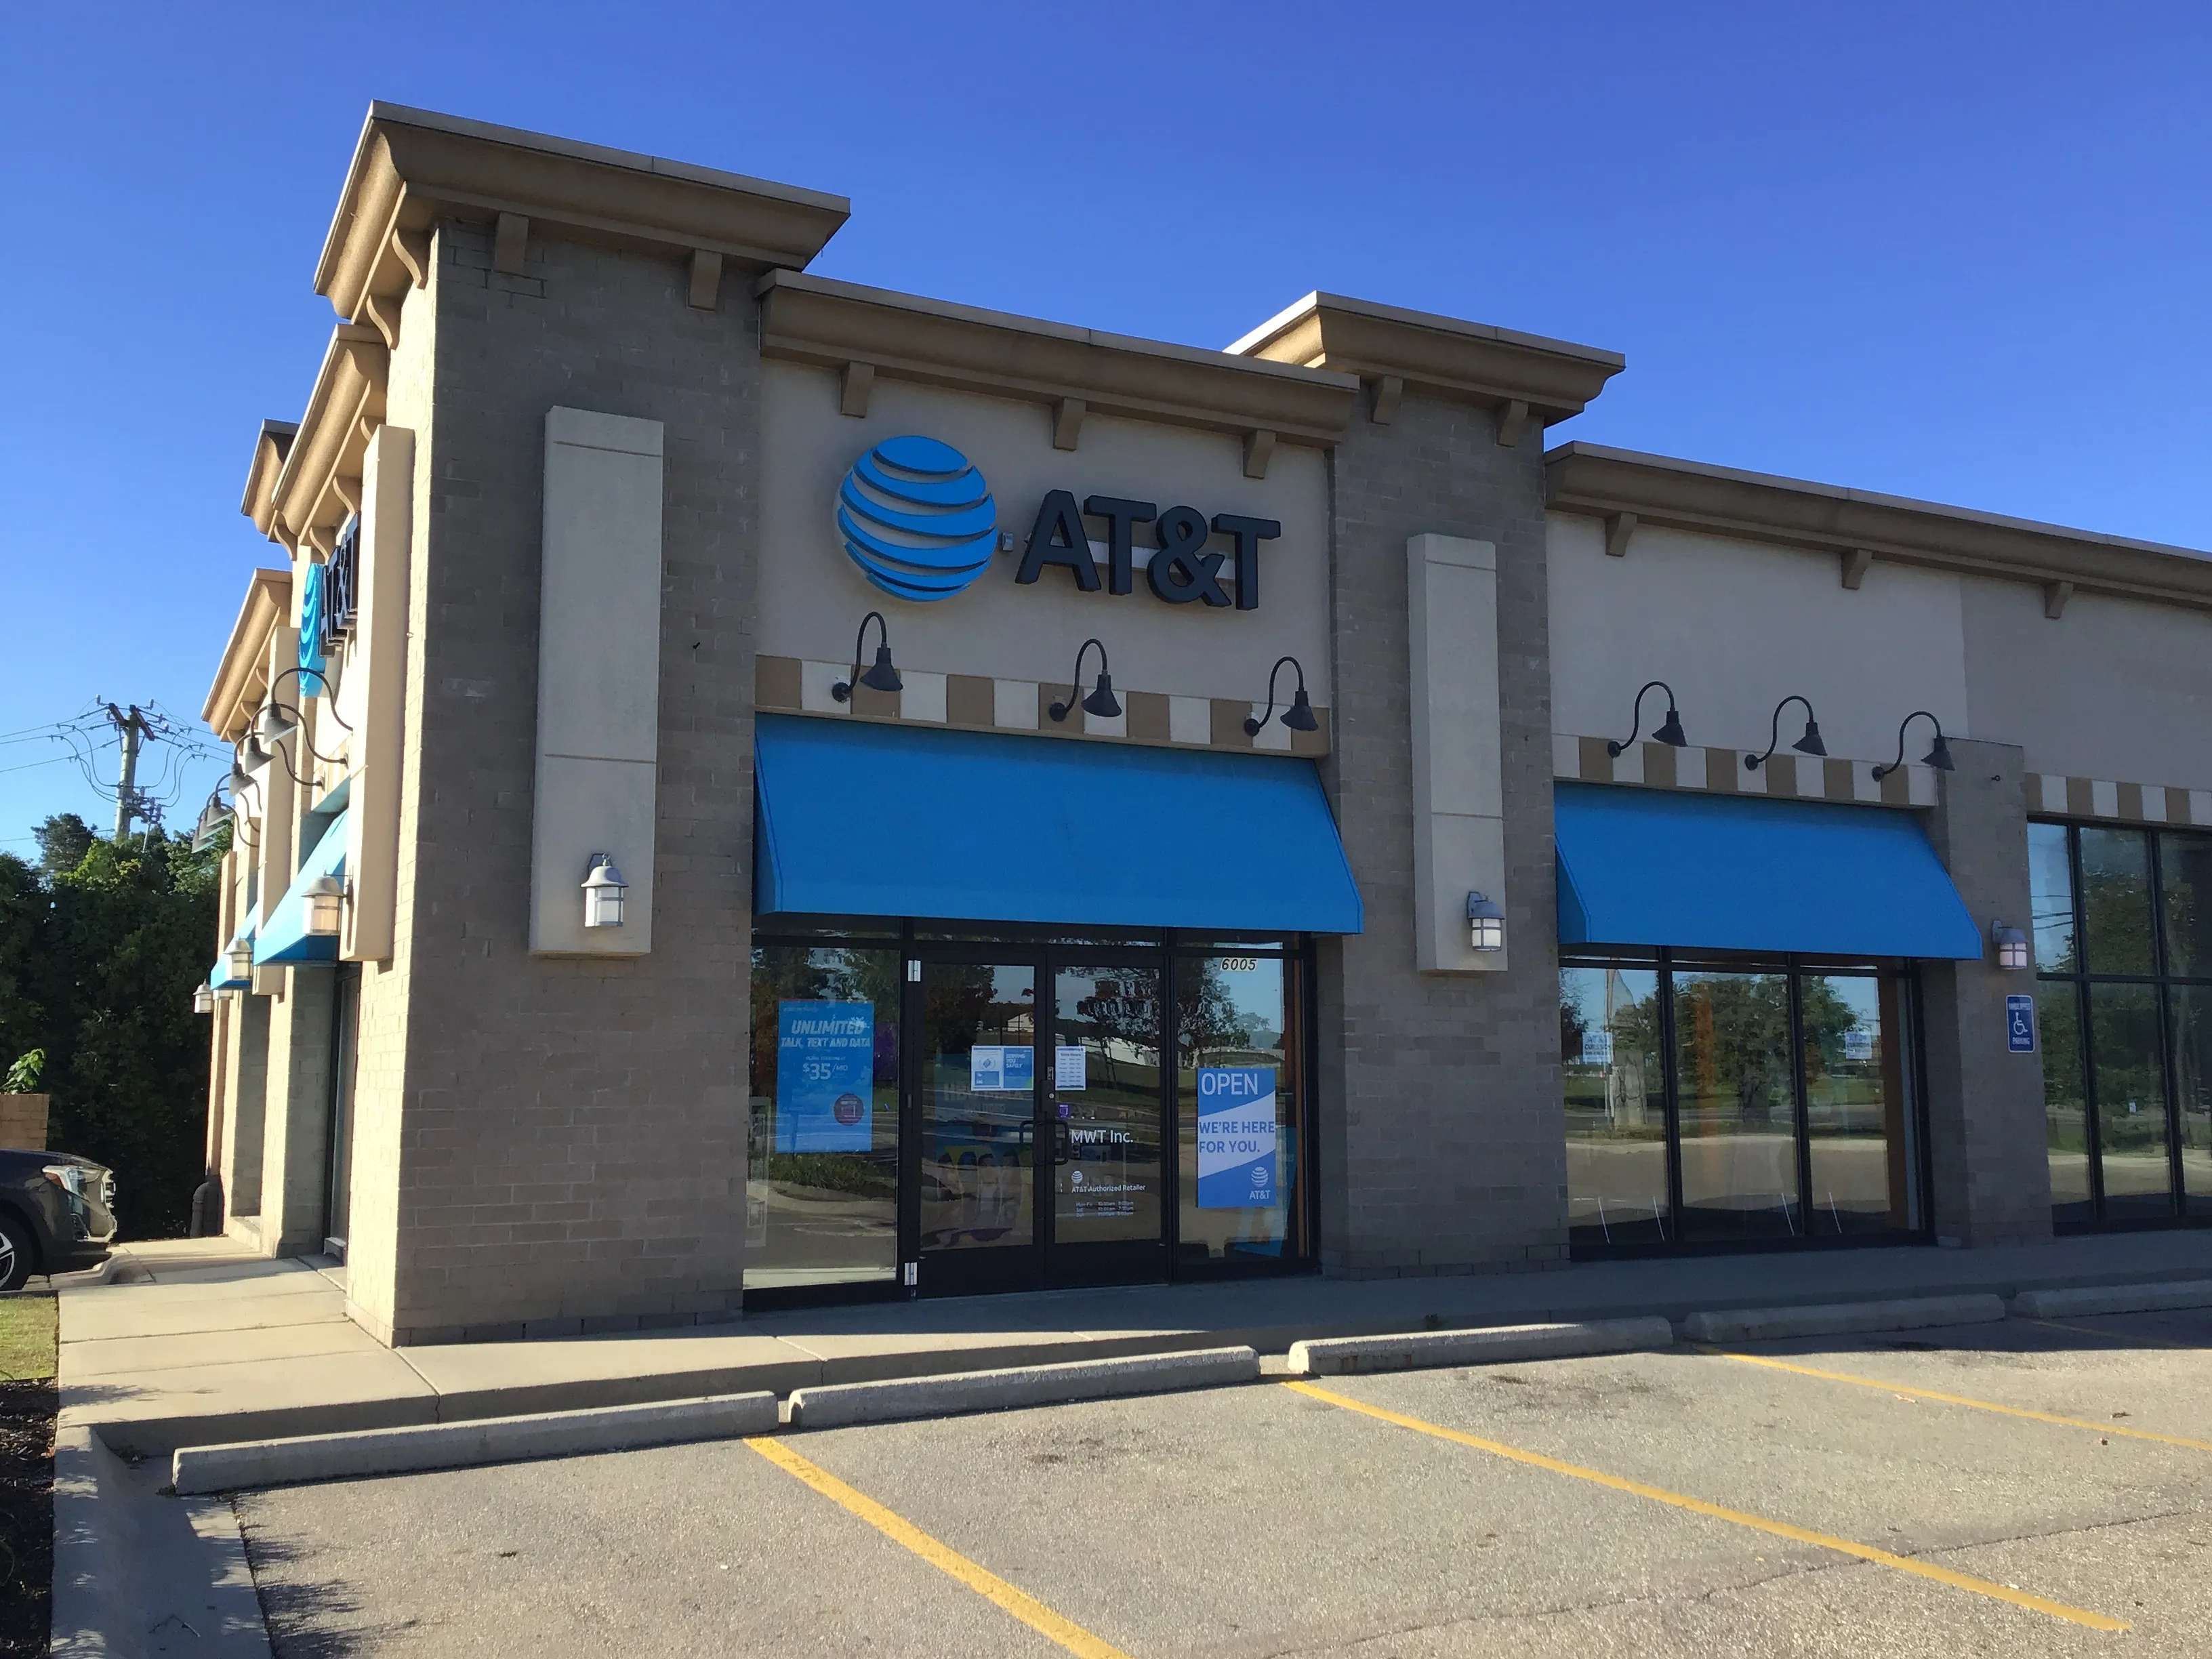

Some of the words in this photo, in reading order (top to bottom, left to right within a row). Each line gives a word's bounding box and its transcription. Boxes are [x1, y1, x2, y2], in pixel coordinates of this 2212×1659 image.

[1015, 489, 1281, 610] AT&T
[1221, 958, 1257, 970] 6005
[791, 1019, 865, 1036] UNLIMITED
[807, 1037, 829, 1048] TEXT
[830, 1038, 848, 1048] AND
[849, 1038, 871, 1048] DATA
[1201, 1072, 1258, 1096] OPEN
[1199, 1121, 1239, 1134] WE'RE
[1242, 1121, 1275, 1134] HERE
[1071, 1130, 1107, 1144] MWT
[1110, 1130, 1134, 1143] Inc.
[1199, 1141, 1225, 1153] FOR
[1228, 1141, 1261, 1153] YOU.
[1071, 1185, 1088, 1193] AT&T
[1249, 1190, 1271, 1200] AT&T
